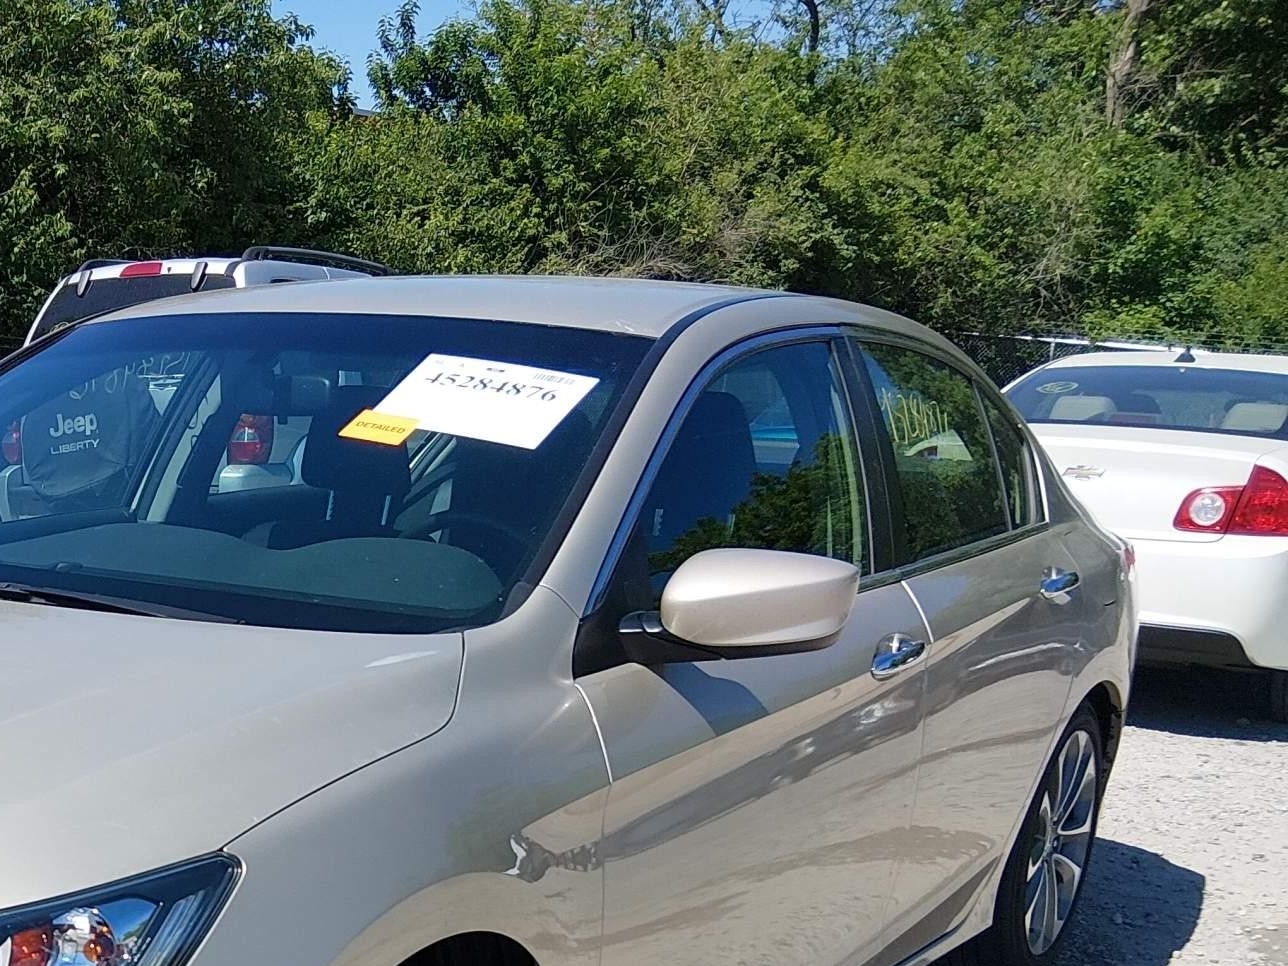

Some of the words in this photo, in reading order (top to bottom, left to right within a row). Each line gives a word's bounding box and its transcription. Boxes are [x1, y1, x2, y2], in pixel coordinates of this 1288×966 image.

[425, 372, 559, 402] 45284876
[50, 413, 97, 437] Jeep
[356, 420, 406, 435] DETAILED
[51, 439, 101, 455] LIBERTY
